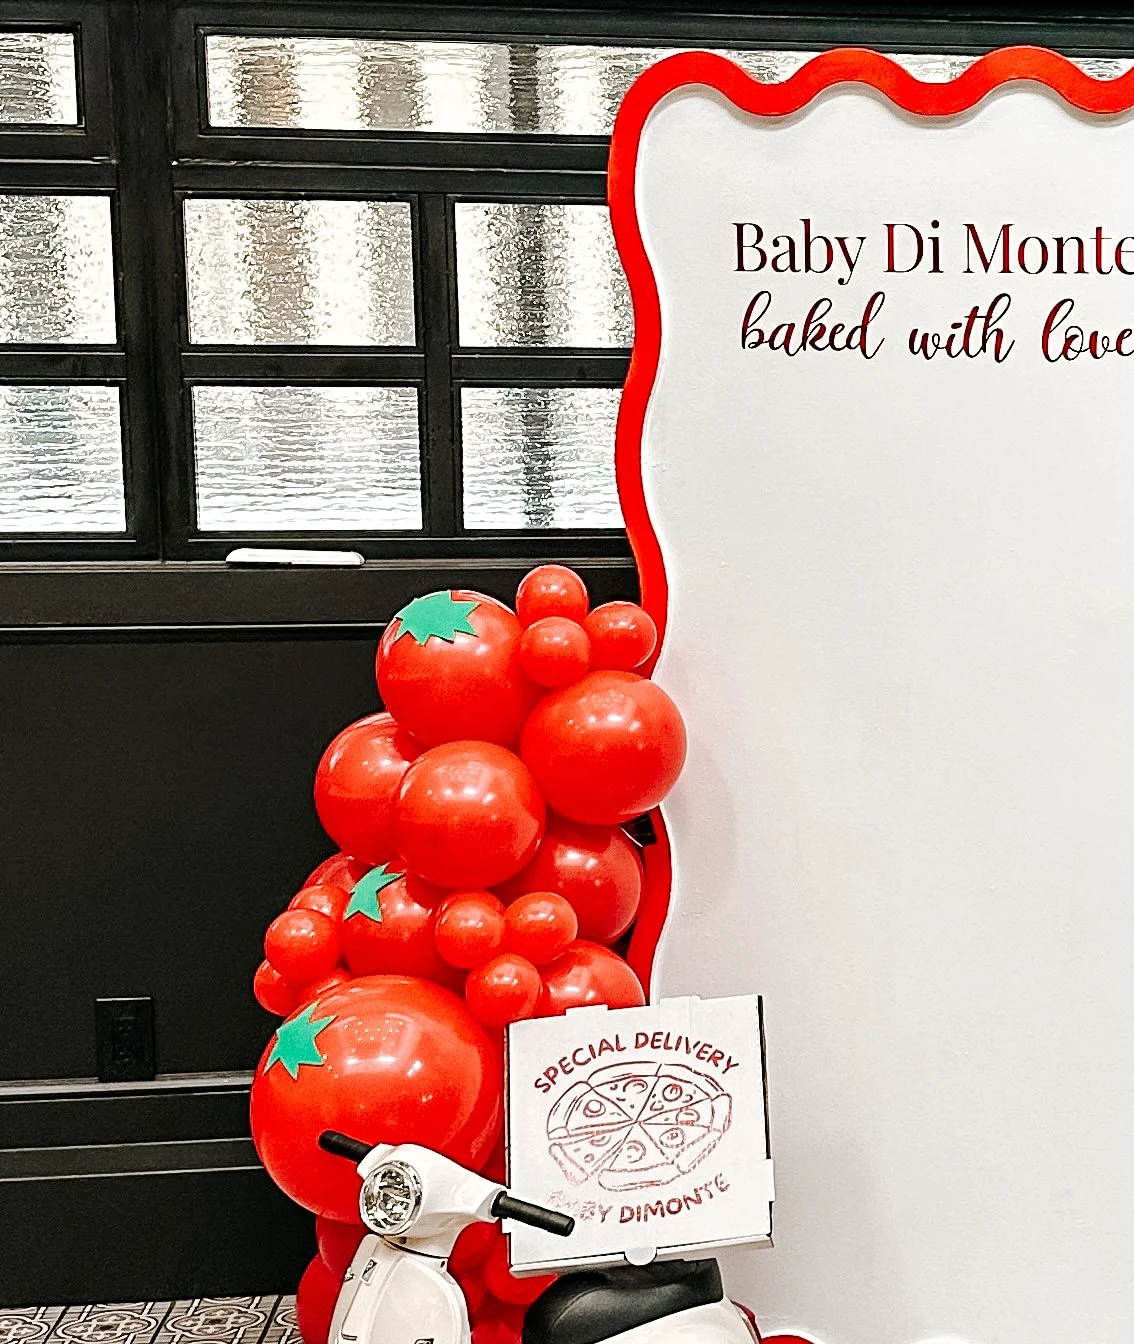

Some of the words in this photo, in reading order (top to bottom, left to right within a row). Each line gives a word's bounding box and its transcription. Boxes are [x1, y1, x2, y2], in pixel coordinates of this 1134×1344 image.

[733, 218, 867, 286] Baby
[882, 219, 944, 274] Di
[741, 290, 886, 360] baked
[908, 293, 1016, 364] with
[534, 1034, 627, 1094] SPECIAL
[634, 1031, 740, 1075] DELIVERY
[619, 1172, 731, 1224] DIMONTE
